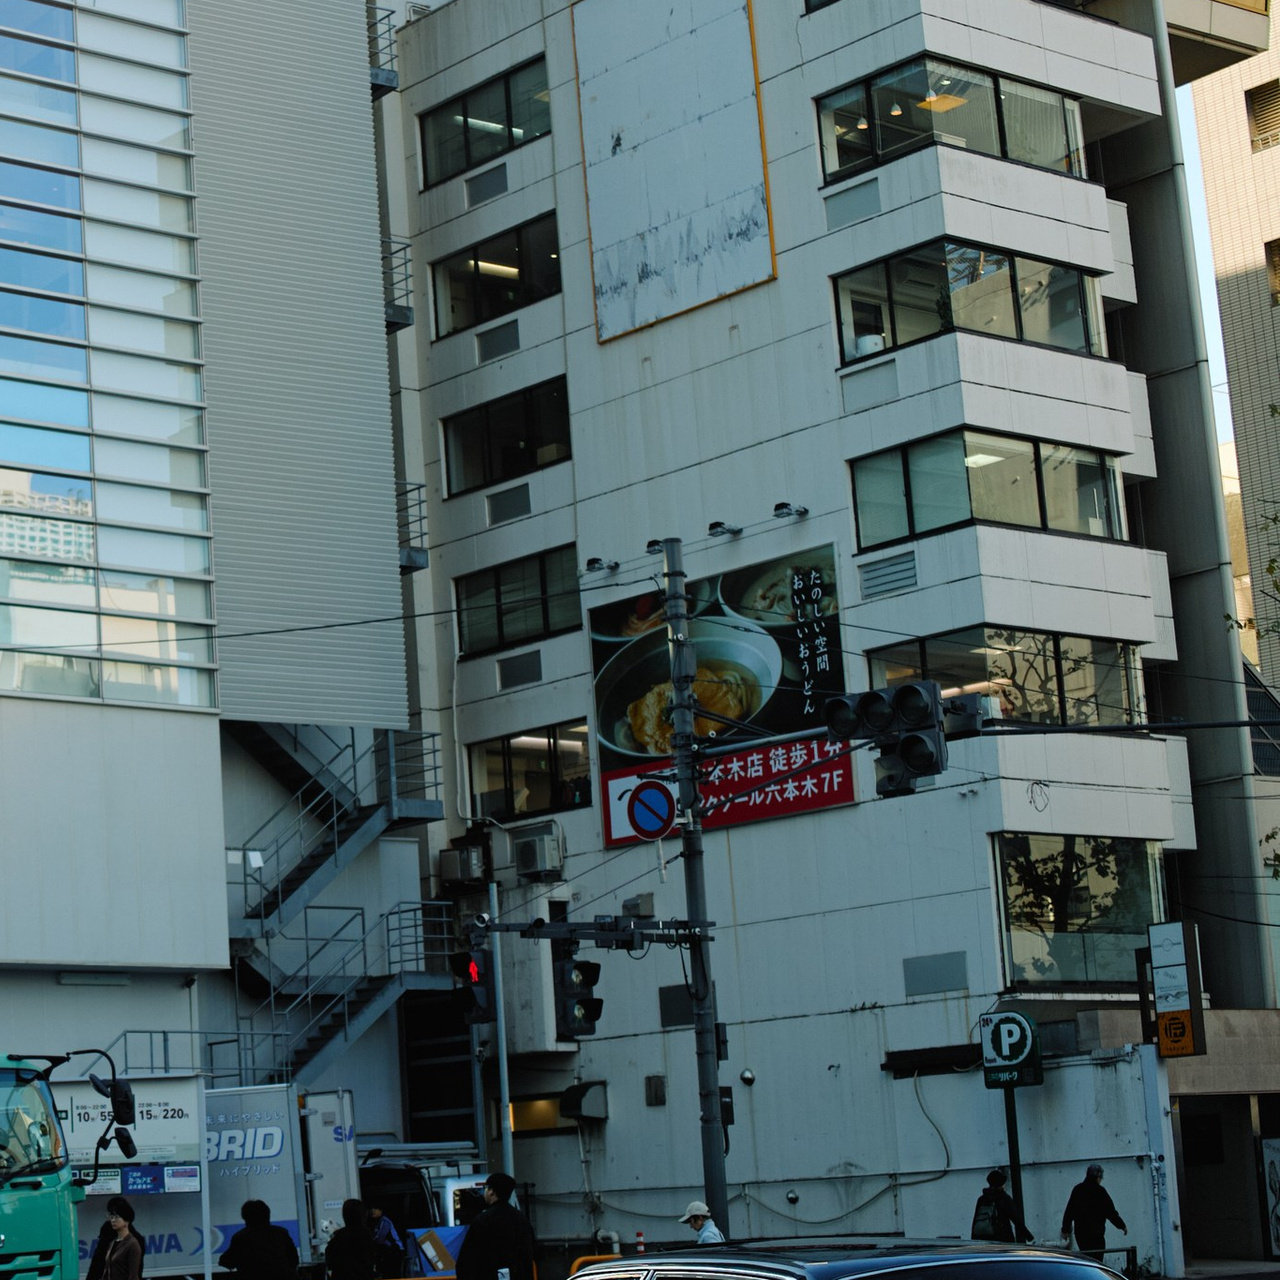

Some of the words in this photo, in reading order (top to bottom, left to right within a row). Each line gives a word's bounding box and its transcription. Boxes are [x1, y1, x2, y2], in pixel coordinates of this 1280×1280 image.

[809, 570, 830, 673] たのしい空間
[792, 574, 816, 715] おいしいおうどん
[1000, 1023, 1022, 1057] P
[206, 1126, 284, 1162] BRID
[220, 1163, 280, 1177] ハイブリッド
